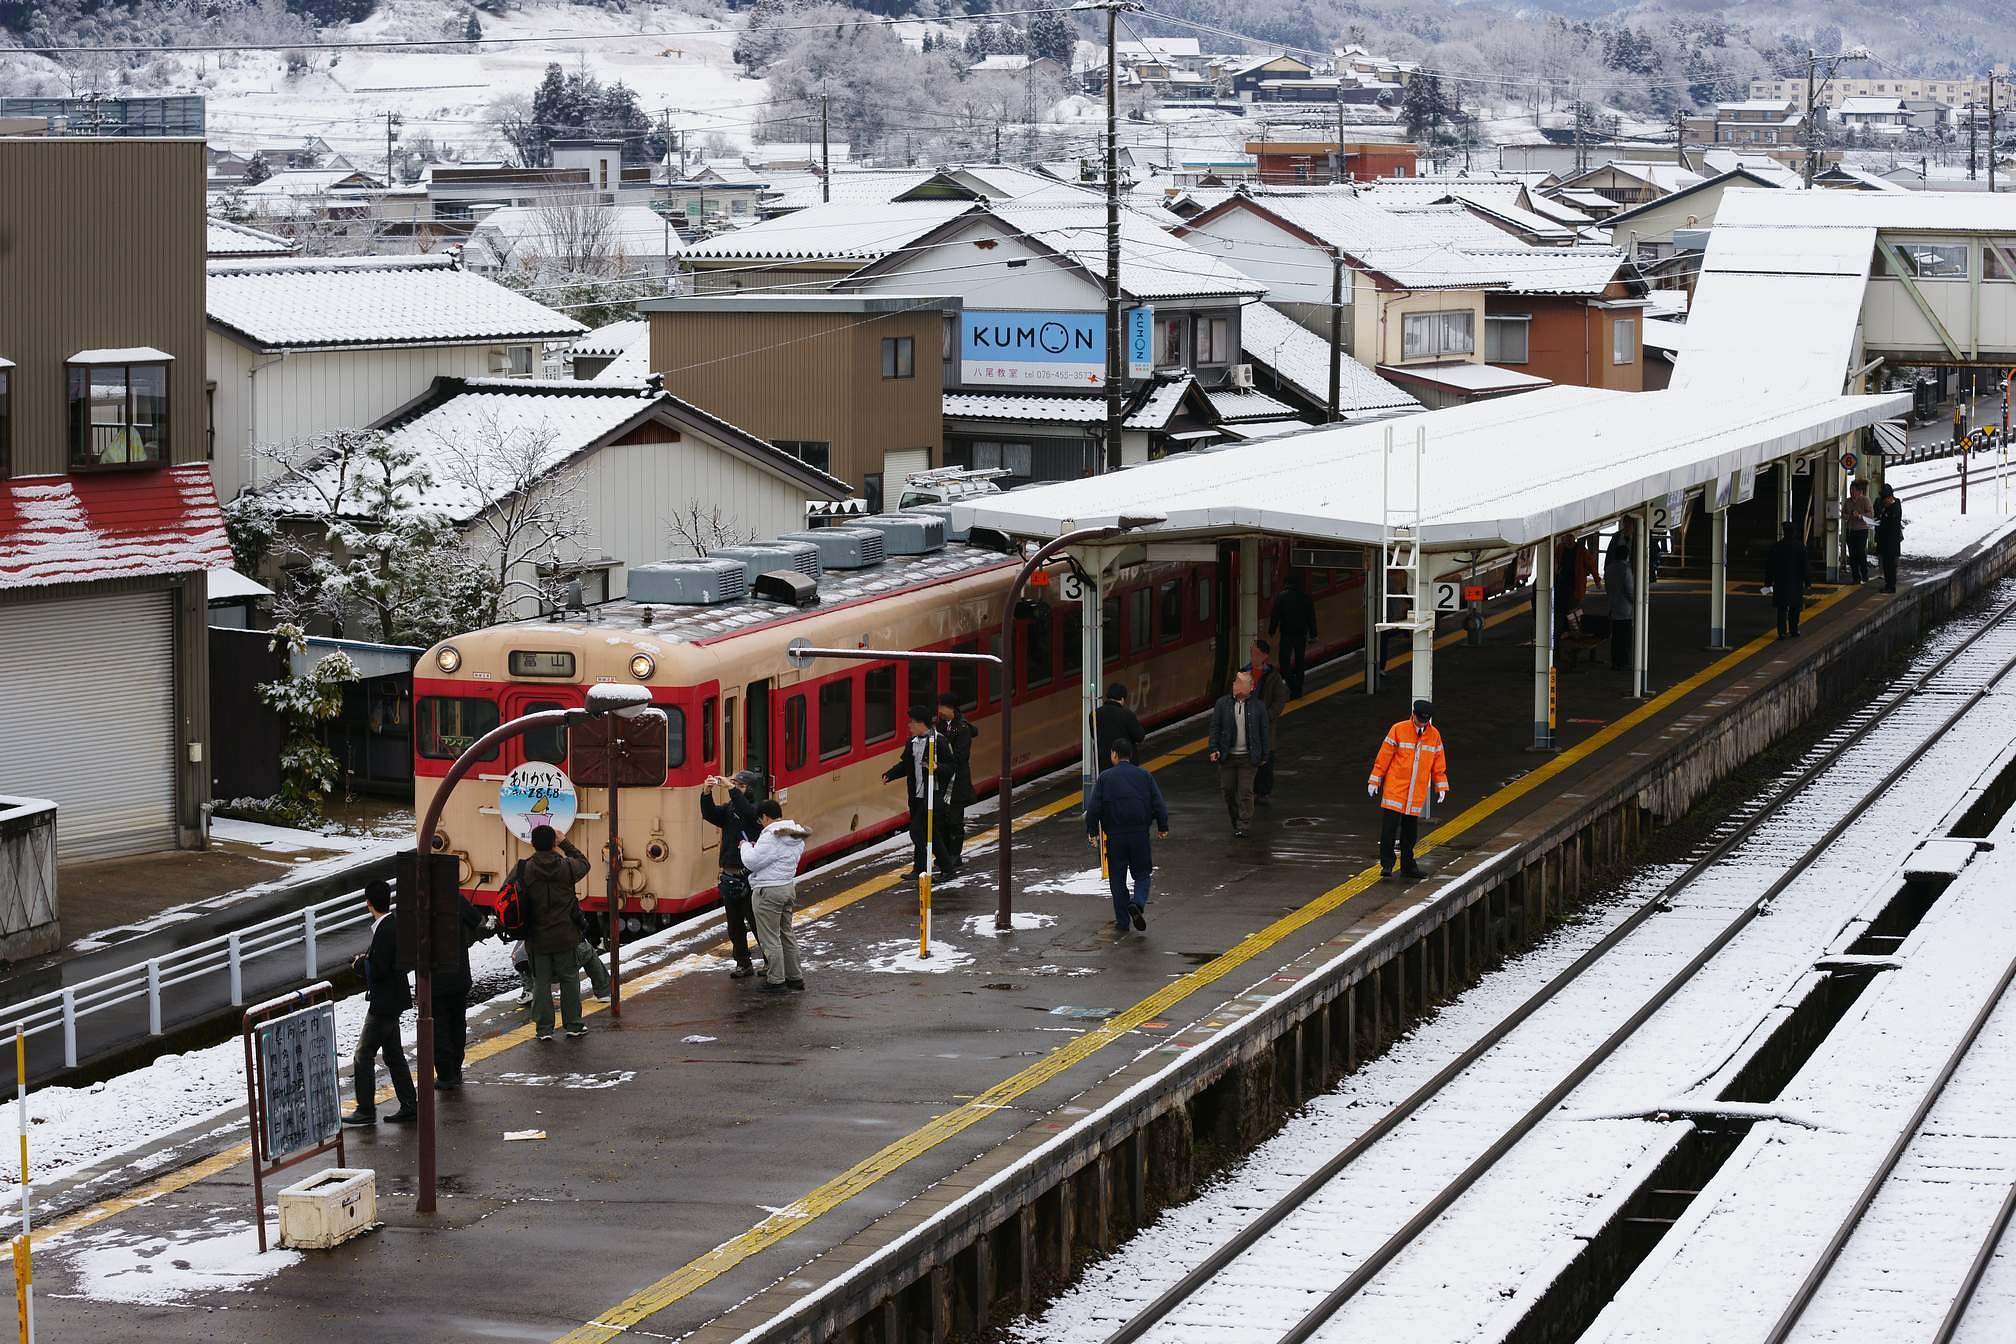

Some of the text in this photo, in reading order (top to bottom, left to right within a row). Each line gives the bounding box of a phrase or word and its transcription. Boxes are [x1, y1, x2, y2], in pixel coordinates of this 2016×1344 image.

[973, 322, 1093, 353] KUMON
[1135, 312, 1146, 360] KUMON
[973, 367, 1018, 379] 八尾教室
[1025, 369, 1034, 379] tel
[1794, 457, 1807, 474] 2
[1653, 508, 1667, 529] 2
[1065, 575, 1082, 599] 3
[1437, 584, 1454, 609] 2
[523, 653, 565, 667] 富山
[1129, 672, 1151, 712] JR
[510, 770, 563, 789] ありがとう
